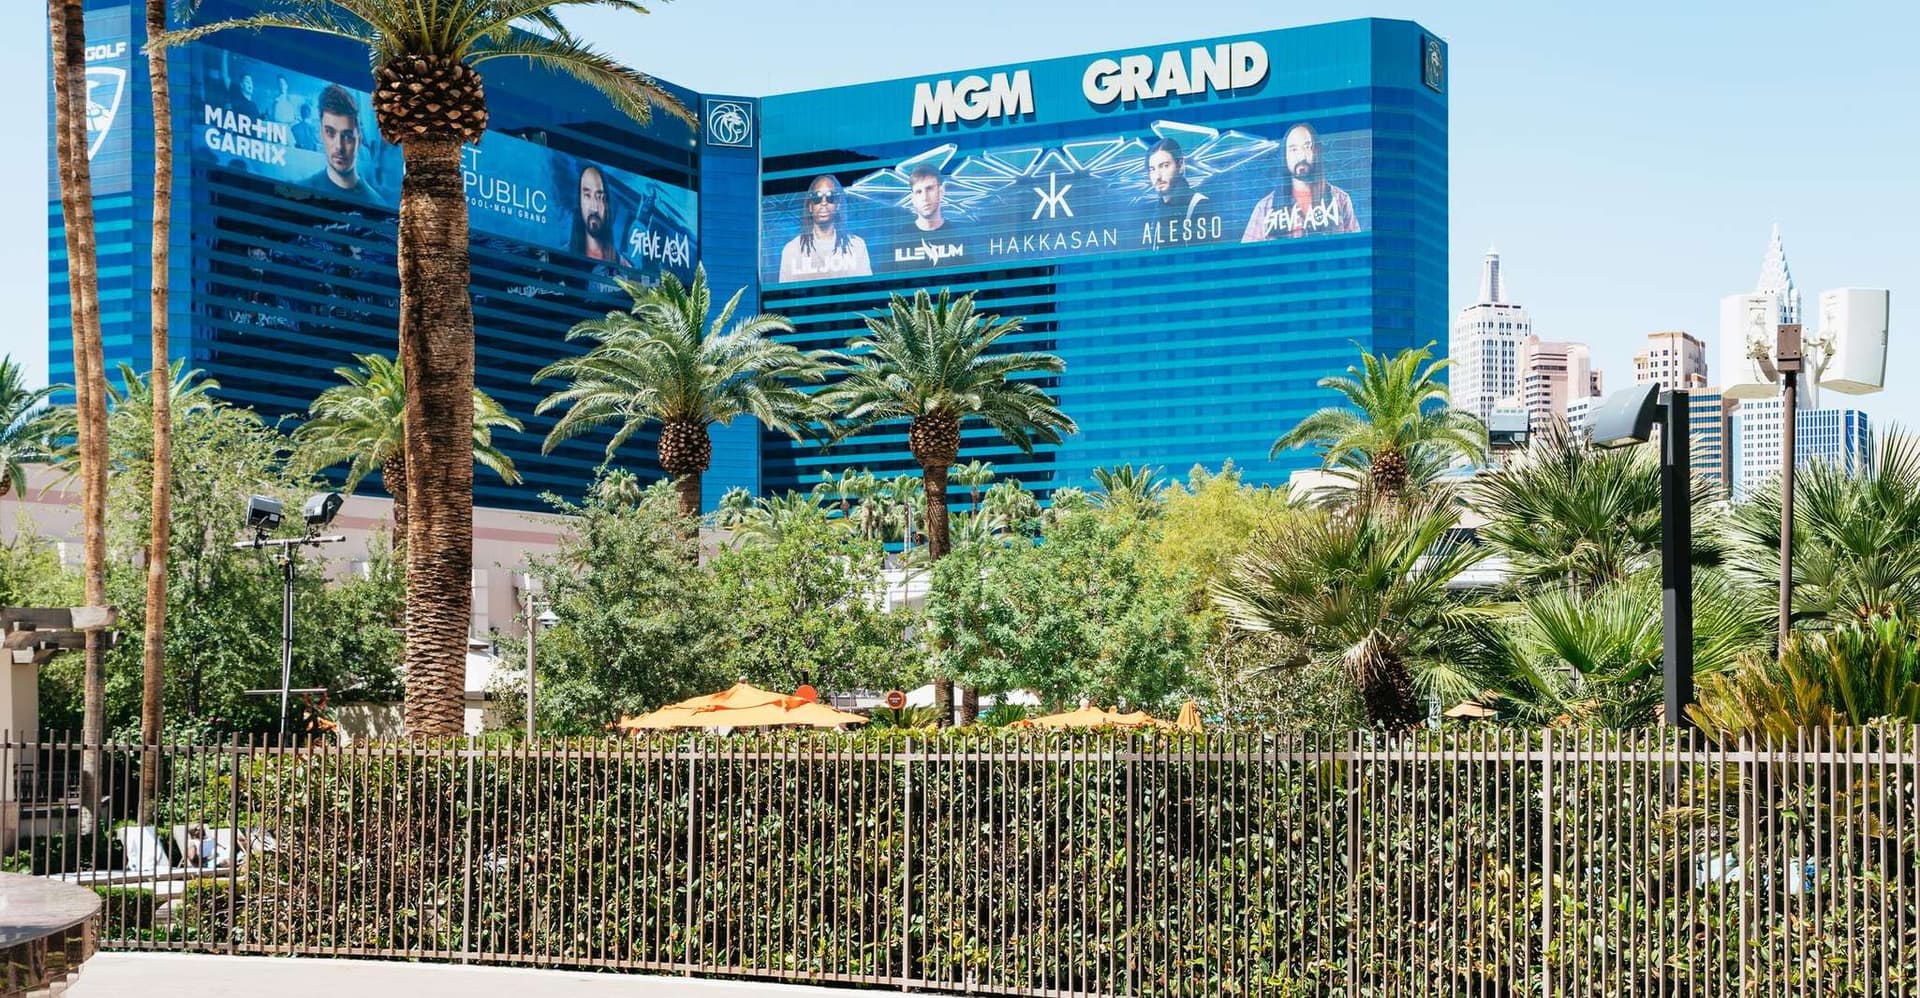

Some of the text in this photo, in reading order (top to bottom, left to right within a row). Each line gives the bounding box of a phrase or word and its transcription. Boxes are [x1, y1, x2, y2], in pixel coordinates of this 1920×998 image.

[84, 41, 127, 62] GOLF
[911, 41, 1269, 127] MGM GRAND
[204, 127, 287, 167] GARRIX
[463, 170, 547, 213] PUBLIC
[517, 209, 547, 224] GRAND
[1142, 215, 1222, 250] ALESSO
[1264, 205, 1302, 236] STEVE
[630, 228, 661, 261] STEVE
[990, 228, 1117, 256] HAKKASAN
[818, 253, 857, 273] JON
